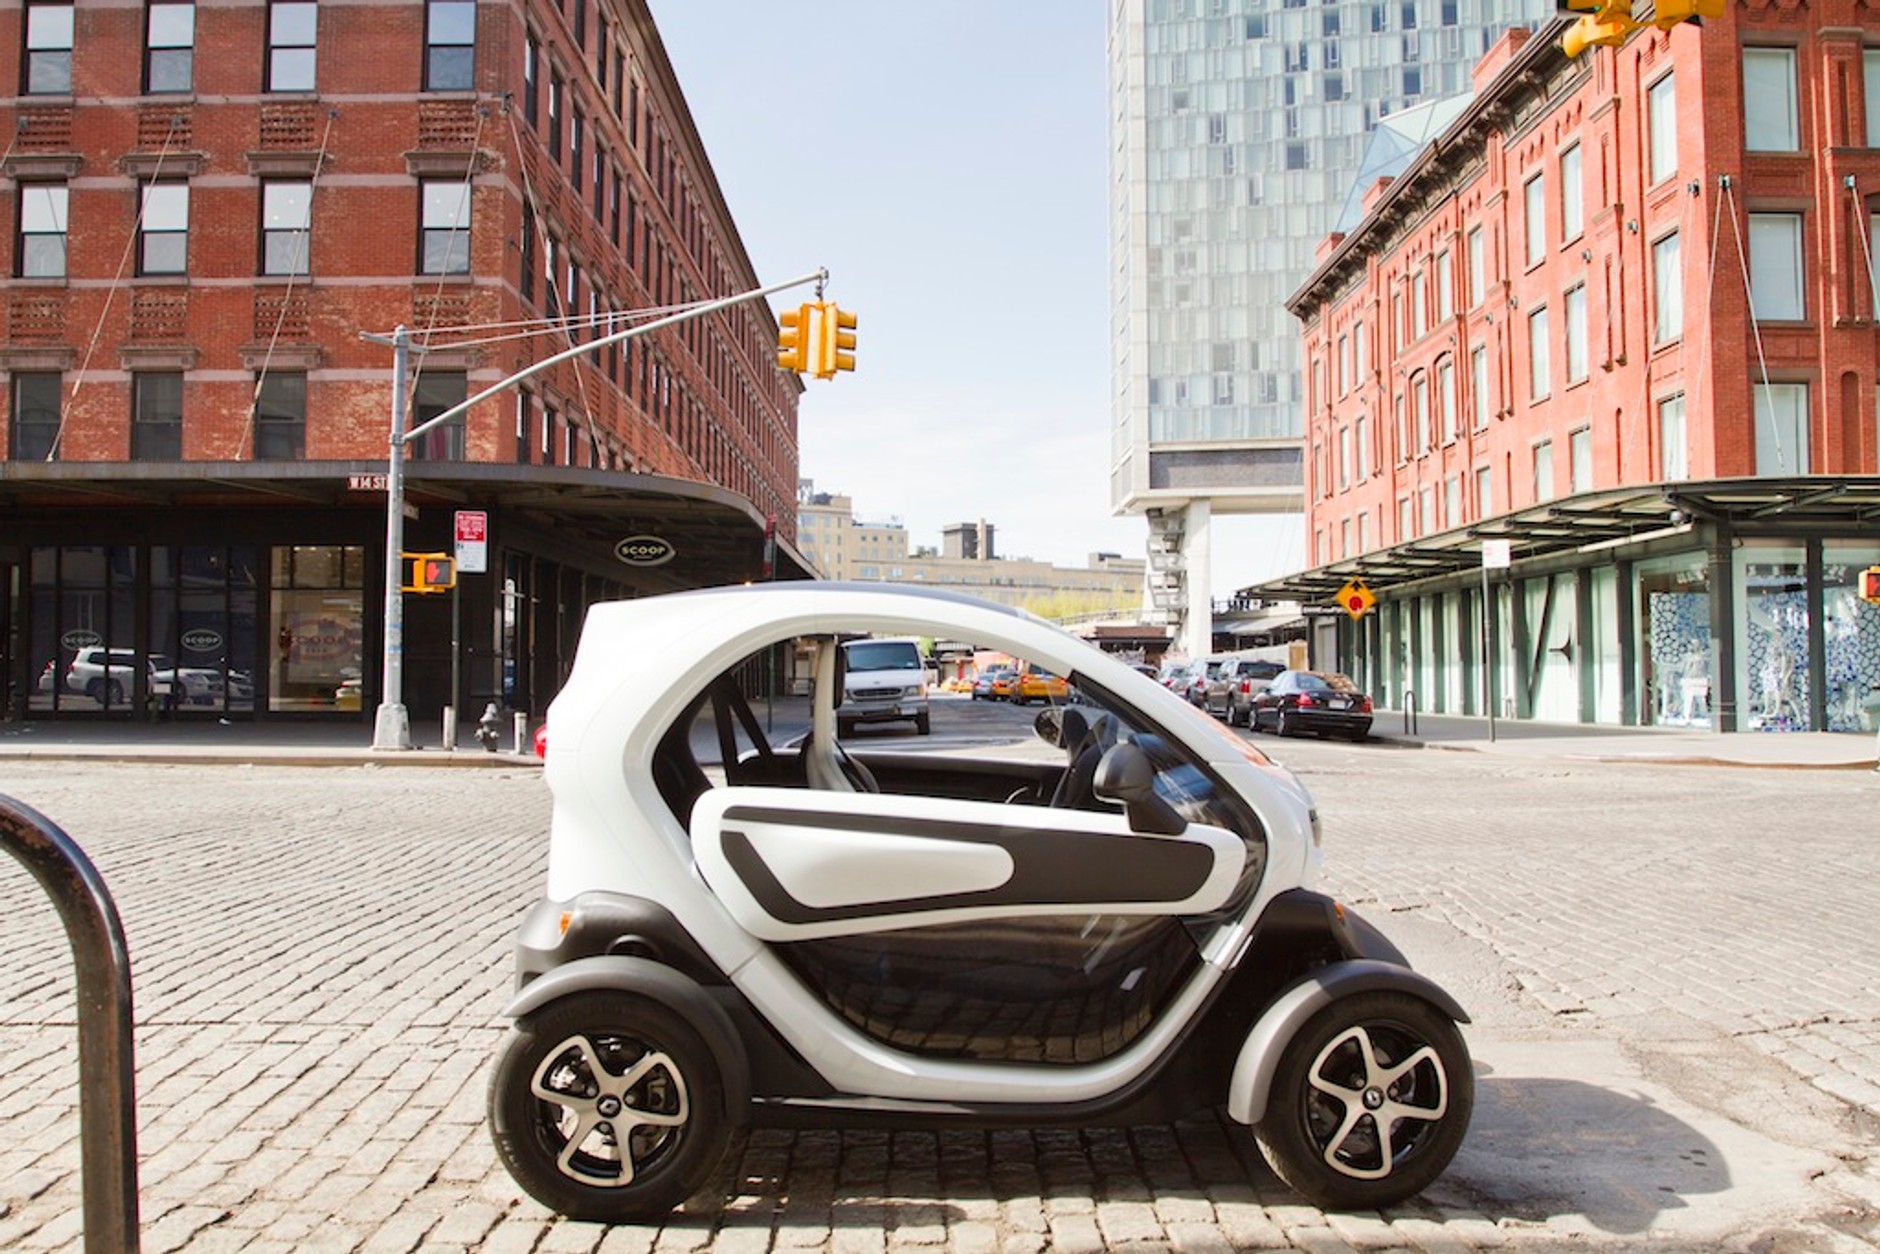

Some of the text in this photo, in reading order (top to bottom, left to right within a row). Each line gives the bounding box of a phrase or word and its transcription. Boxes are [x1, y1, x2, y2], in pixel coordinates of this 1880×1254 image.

[349, 476, 360, 490] W
[372, 476, 387, 490] ST
[621, 545, 666, 555] SCOOP
[185, 636, 219, 645] SCOOP
